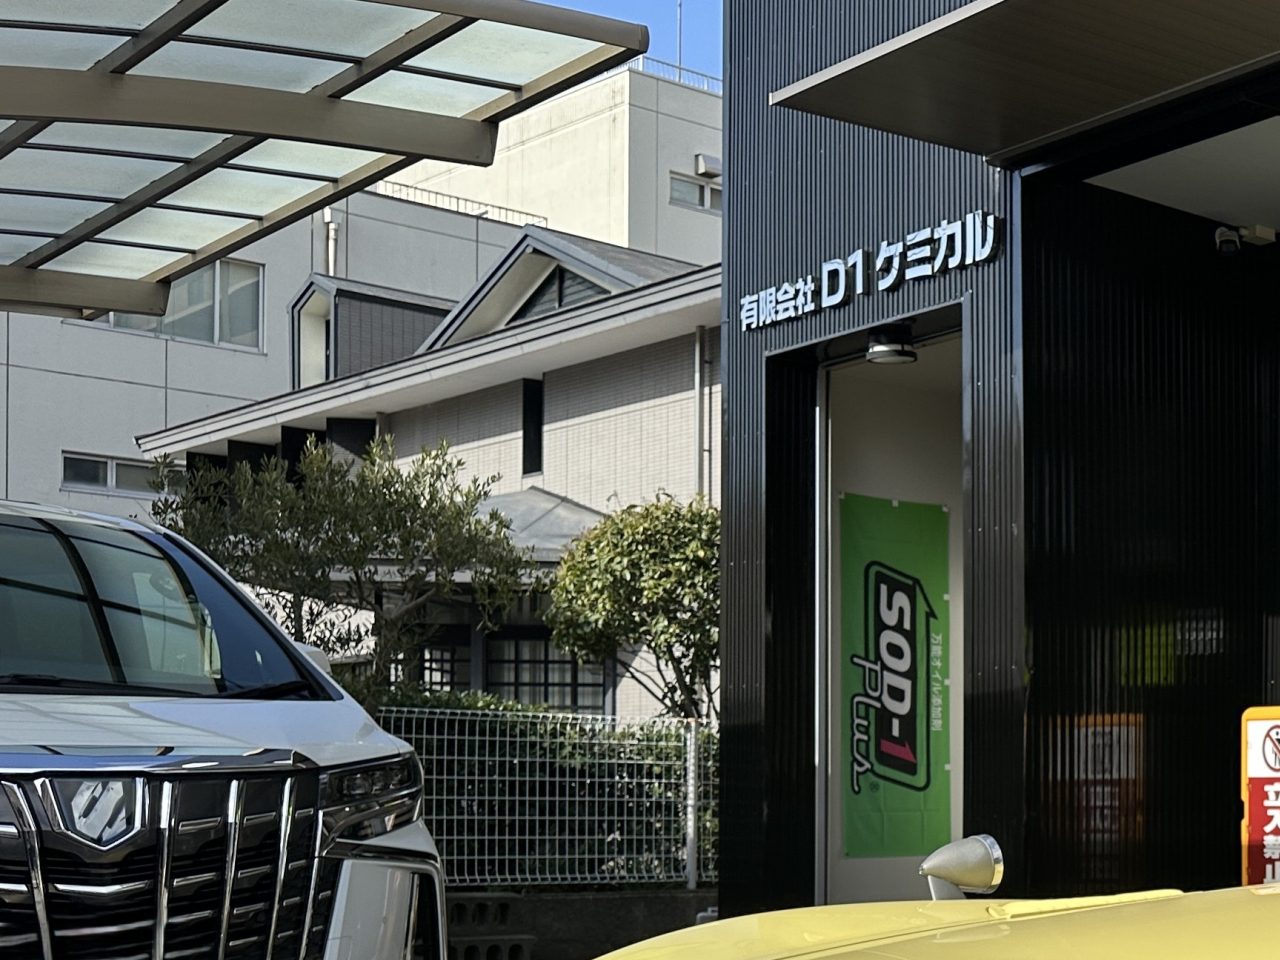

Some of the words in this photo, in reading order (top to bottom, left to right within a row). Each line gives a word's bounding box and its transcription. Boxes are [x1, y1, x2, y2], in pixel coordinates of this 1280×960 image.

[740, 275, 815, 332] 有限会社
[880, 583, 917, 765] SOD-1
